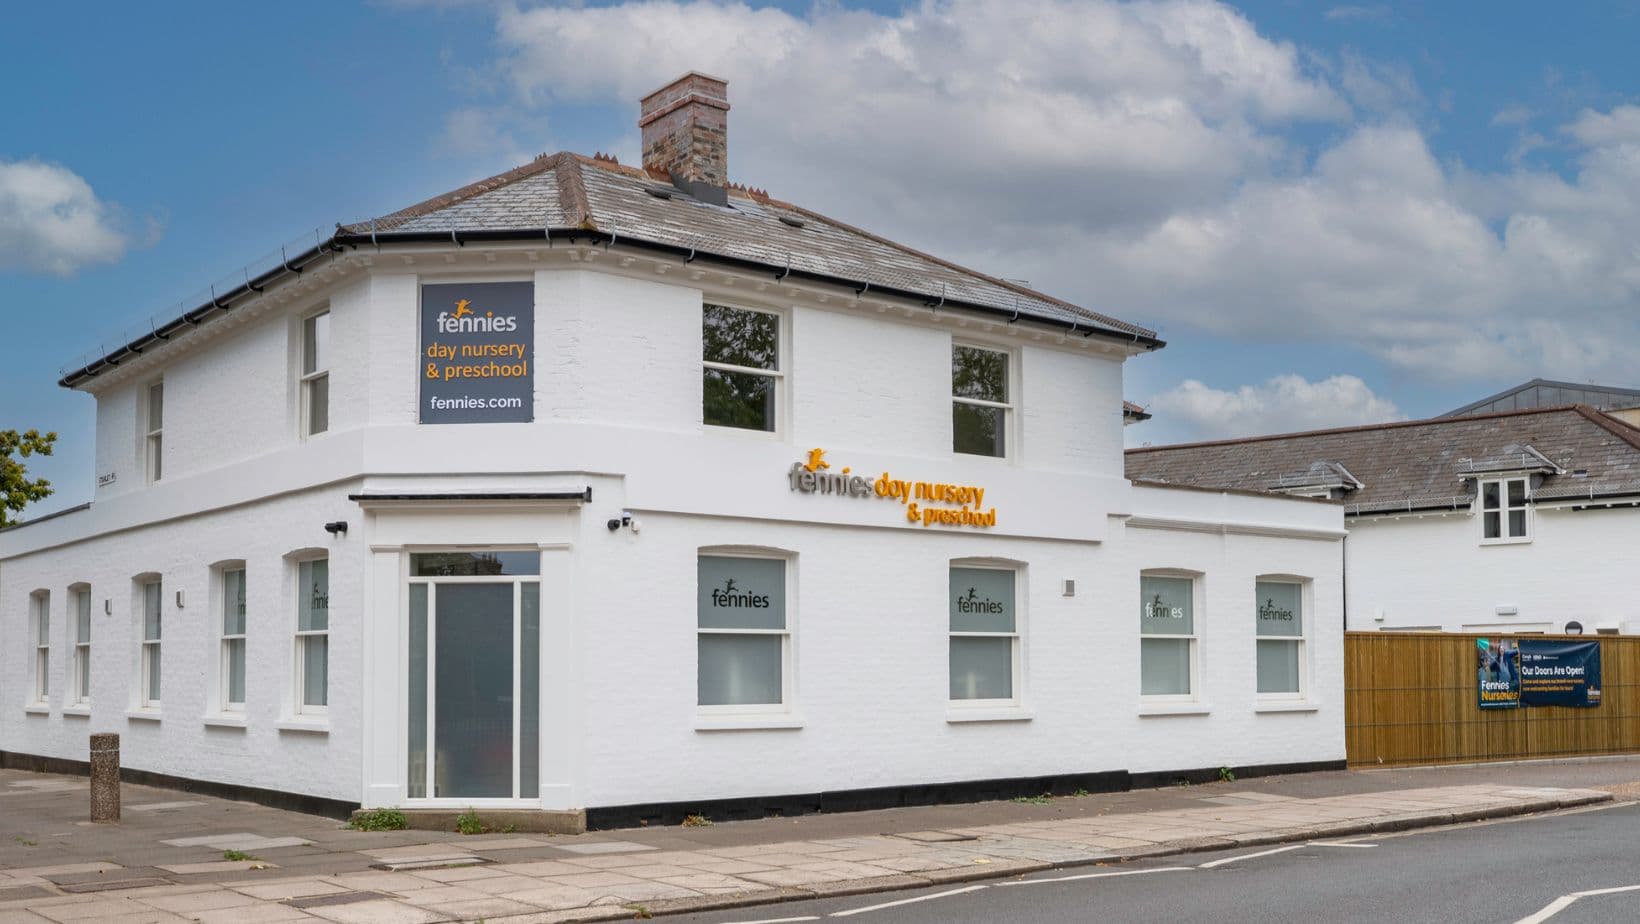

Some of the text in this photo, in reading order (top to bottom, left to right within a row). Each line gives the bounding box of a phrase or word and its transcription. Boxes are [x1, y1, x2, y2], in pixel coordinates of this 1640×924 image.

[437, 311, 517, 333] fennies
[427, 342, 525, 360] day nursery
[426, 361, 527, 381] & preschool
[430, 395, 522, 409] fennies.com
[788, 461, 985, 510] fennies day nursery
[907, 502, 996, 527] & preschool
[712, 589, 769, 608] fennies
[957, 596, 1003, 614] fennies
[1145, 602, 1183, 618] fennes
[1259, 606, 1293, 621] fennies
[1522, 666, 1584, 677] Our Doors Are Open!
[1481, 680, 1510, 690] Fennies
[1481, 690, 1518, 701] Nurseries
